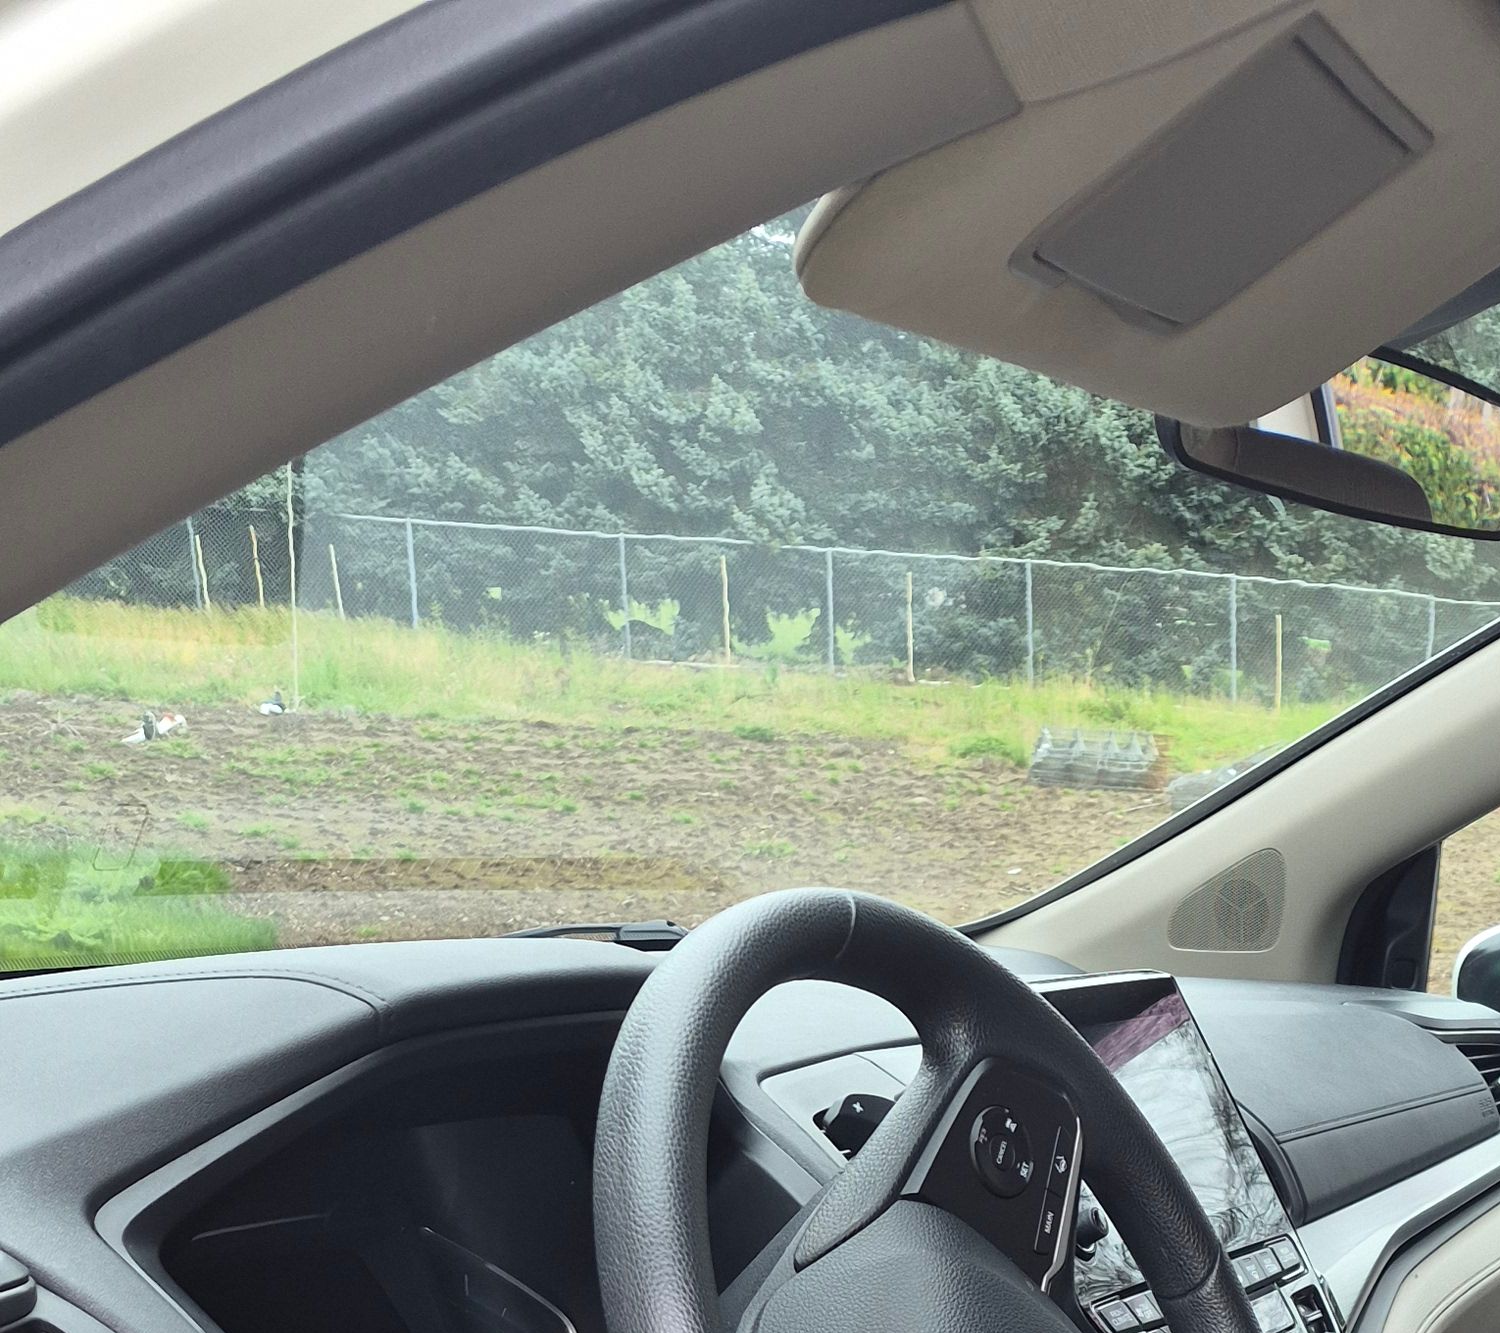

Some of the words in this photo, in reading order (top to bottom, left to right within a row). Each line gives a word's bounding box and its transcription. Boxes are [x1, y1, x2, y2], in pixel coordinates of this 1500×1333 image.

[996, 1140, 1008, 1165] CANCEL
[1020, 1161, 1030, 1178] SET
[1044, 1211, 1055, 1234] MAIN
